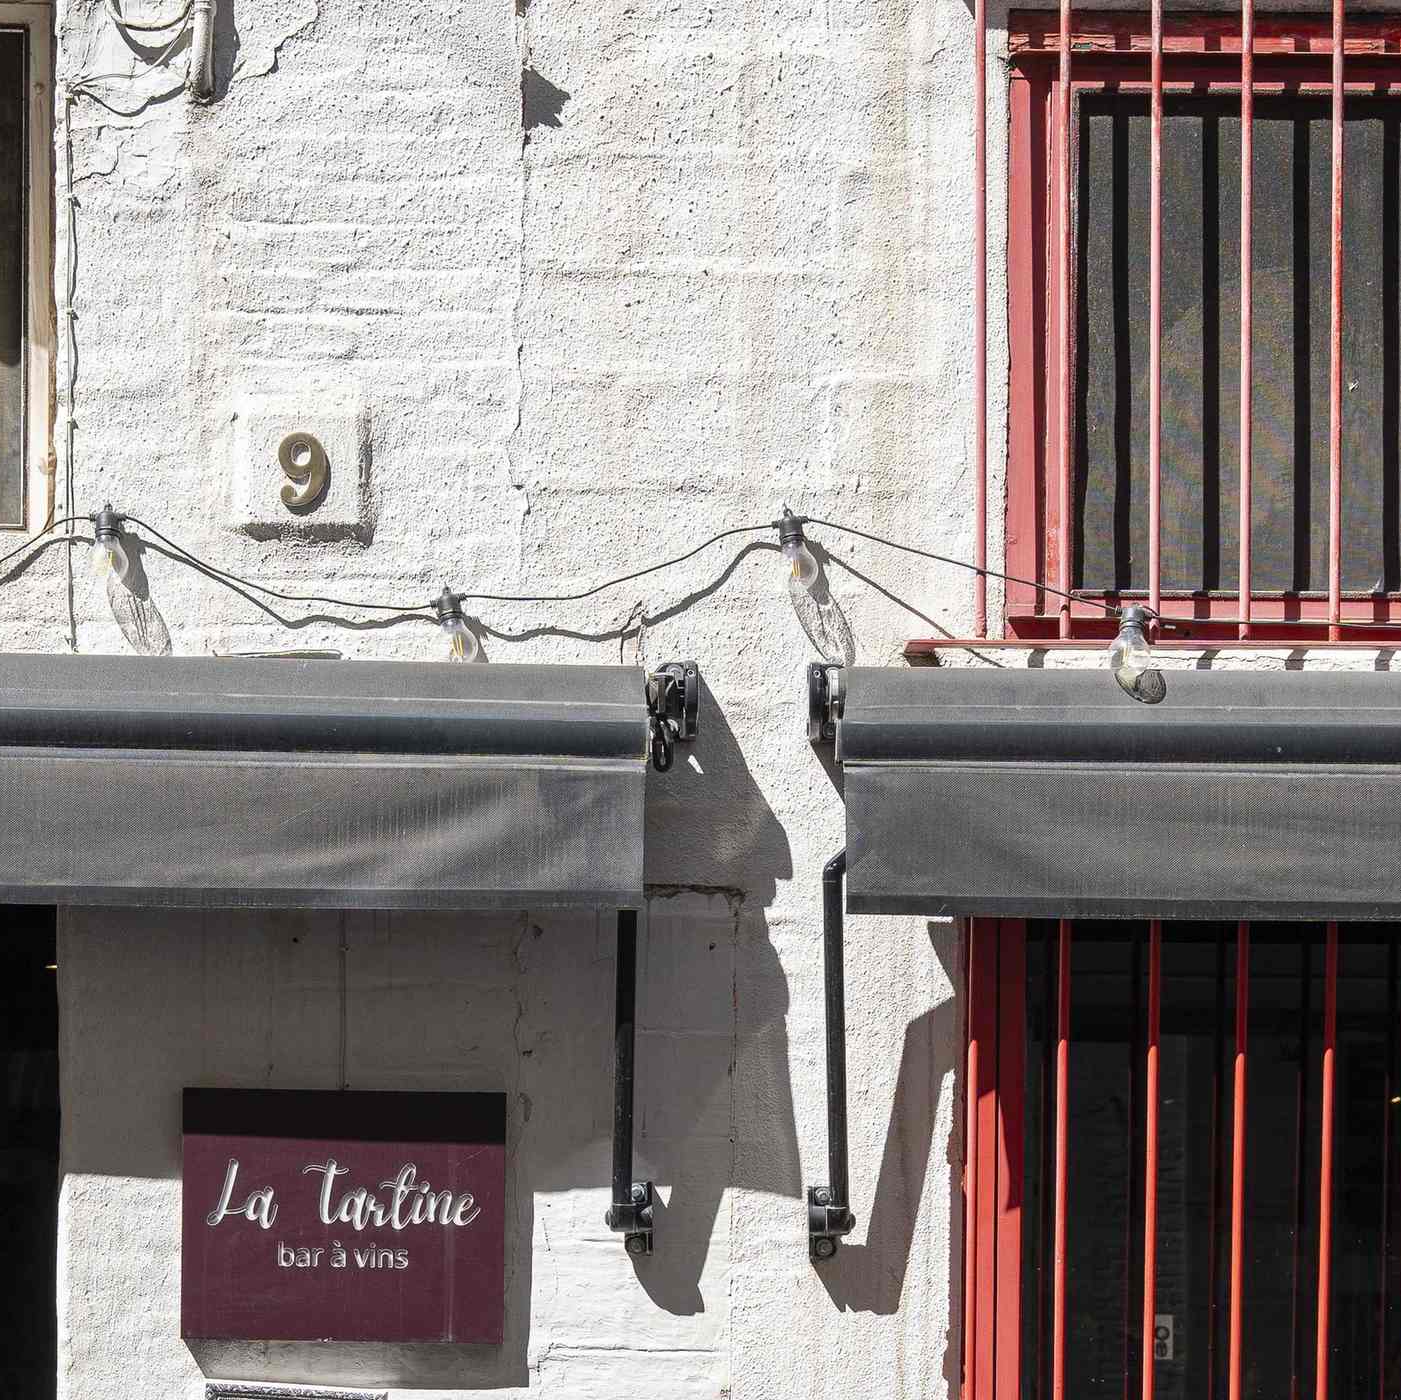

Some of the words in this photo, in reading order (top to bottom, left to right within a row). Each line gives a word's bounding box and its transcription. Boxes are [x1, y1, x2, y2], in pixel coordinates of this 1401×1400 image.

[278, 431, 327, 507] 9
[207, 1158, 279, 1230] La
[302, 1157, 482, 1231] Tartine
[277, 1240, 325, 1268] bar
[330, 1239, 347, 1268] à
[353, 1241, 409, 1269] vins
